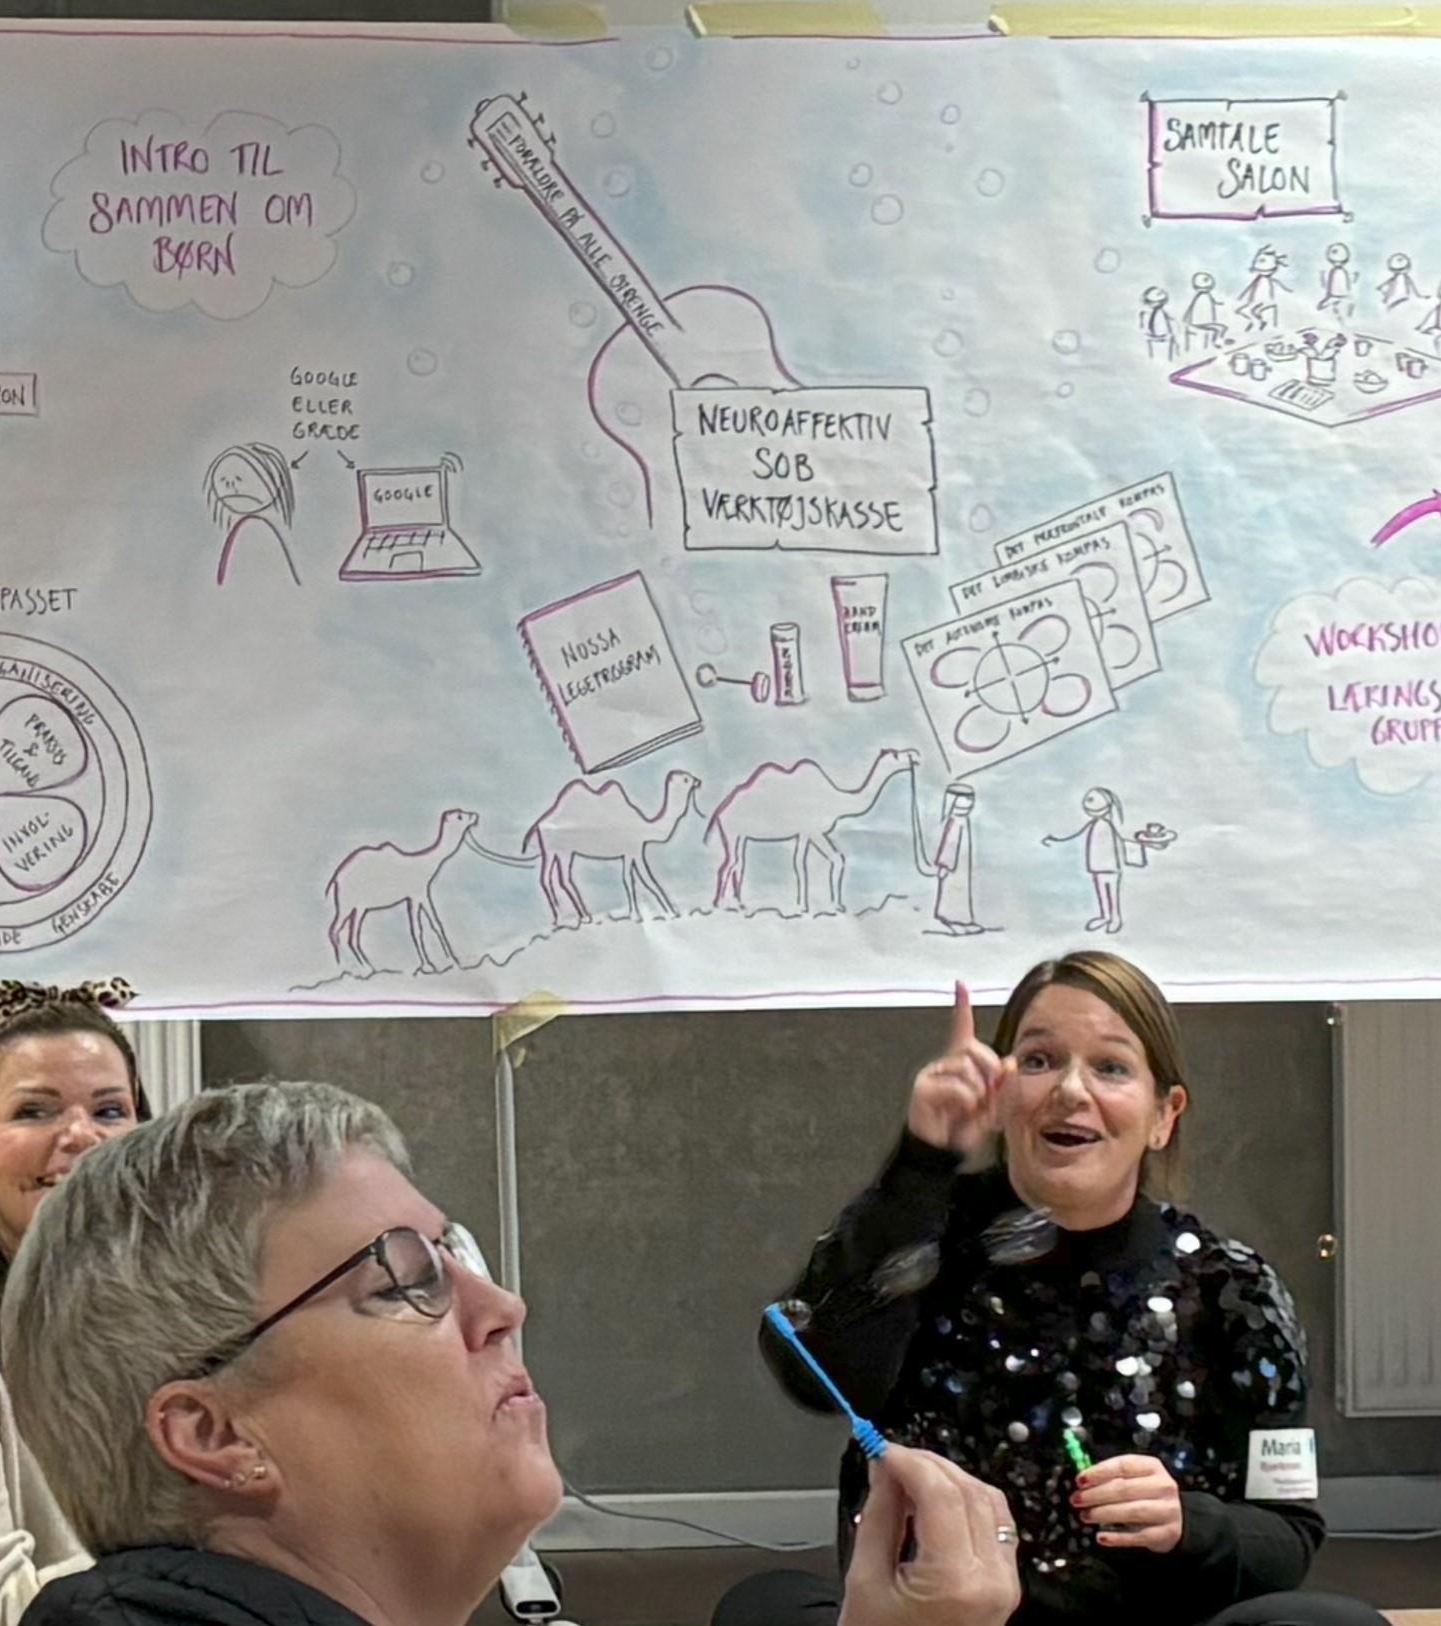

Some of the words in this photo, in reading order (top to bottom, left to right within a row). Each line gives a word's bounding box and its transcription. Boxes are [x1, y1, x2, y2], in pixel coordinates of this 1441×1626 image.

[1163, 117, 1281, 155] SAMTALE
[120, 135, 210, 177] INTRO
[231, 141, 285, 177] TIL
[1218, 157, 1310, 199] SALON
[89, 192, 238, 235] SAMMEN
[265, 192, 313, 228] OM
[152, 233, 237, 276] BØRN
[579, 232, 613, 269] ALLE
[290, 367, 359, 388] GOOGLE
[291, 396, 353, 414] ELLER
[696, 403, 893, 441] NEUROAFFEKTIV
[292, 423, 361, 441] GRÆDE
[752, 447, 815, 483] SOB
[372, 483, 435, 503] GOOGLE
[700, 487, 905, 532] VÆRKTØJSKASSE
